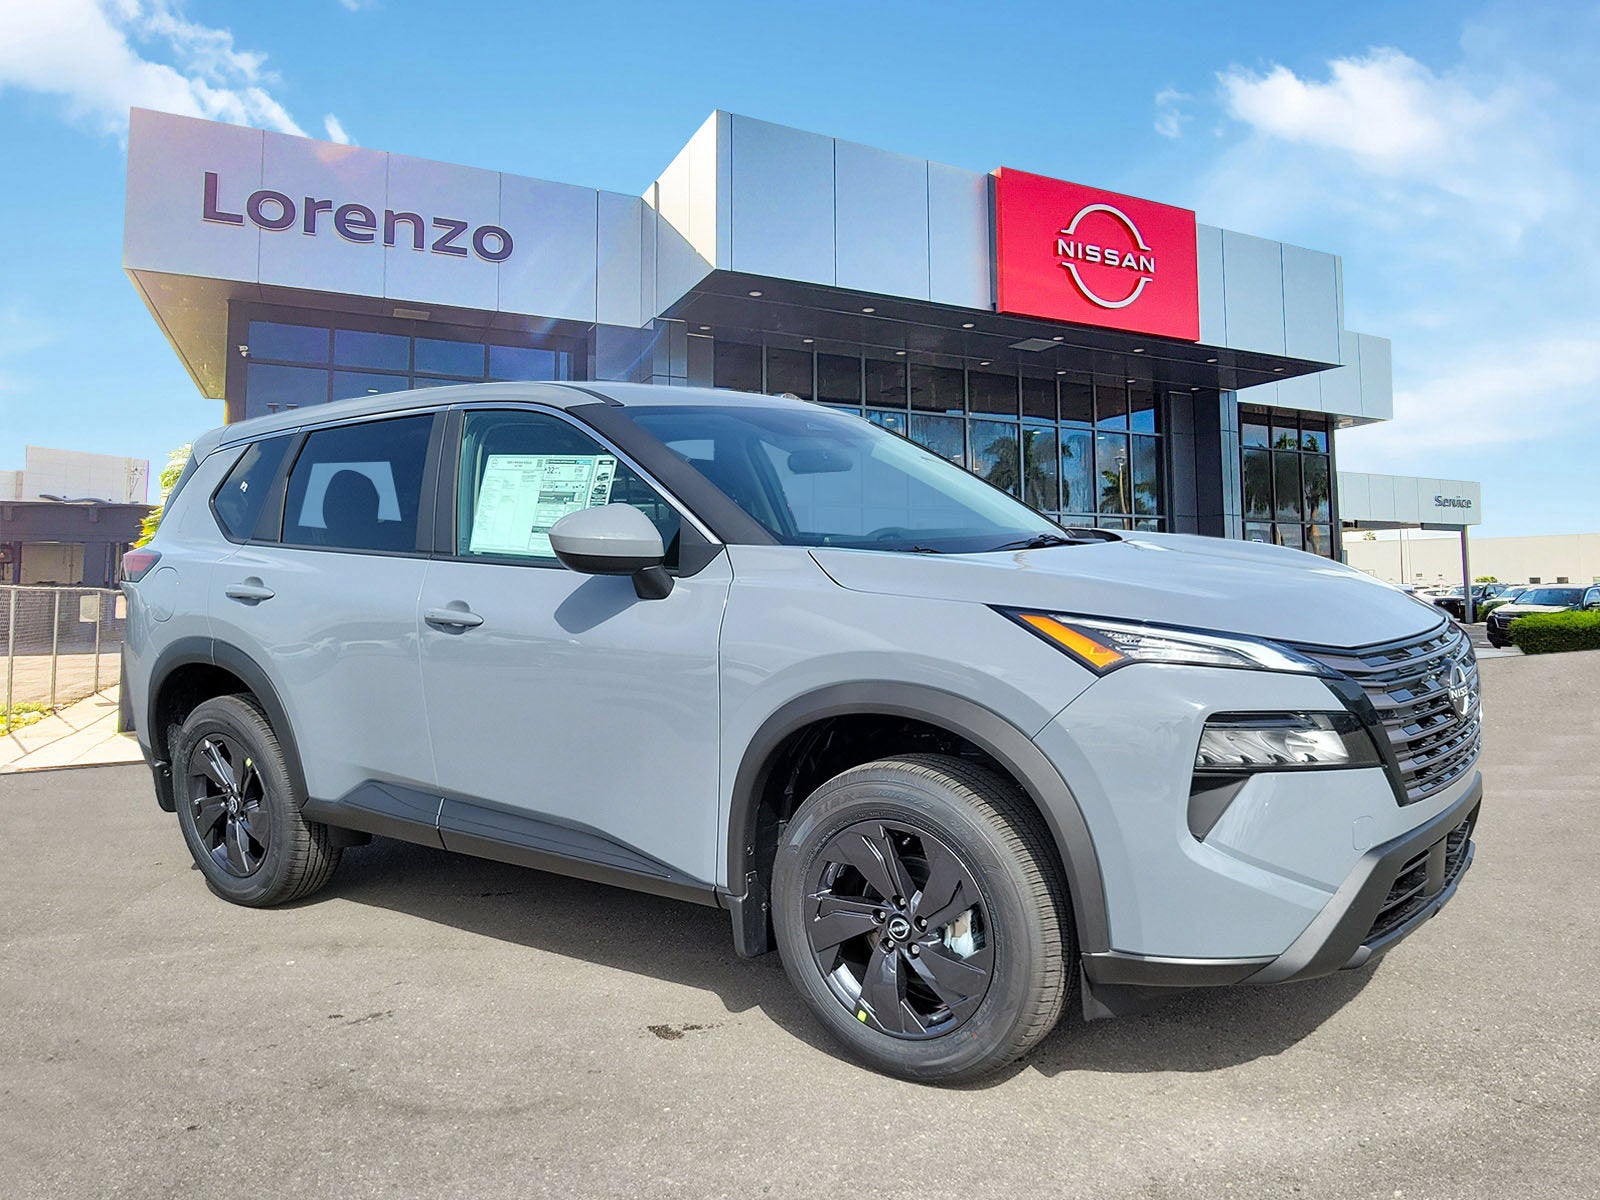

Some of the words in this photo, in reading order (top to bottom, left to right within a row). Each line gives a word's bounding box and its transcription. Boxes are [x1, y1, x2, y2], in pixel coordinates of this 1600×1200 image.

[202, 171, 515, 262] Lorenzo
[1057, 238, 1155, 273] NISSAN
[1434, 495, 1472, 509] Service
[1451, 685, 1468, 699] NISS
